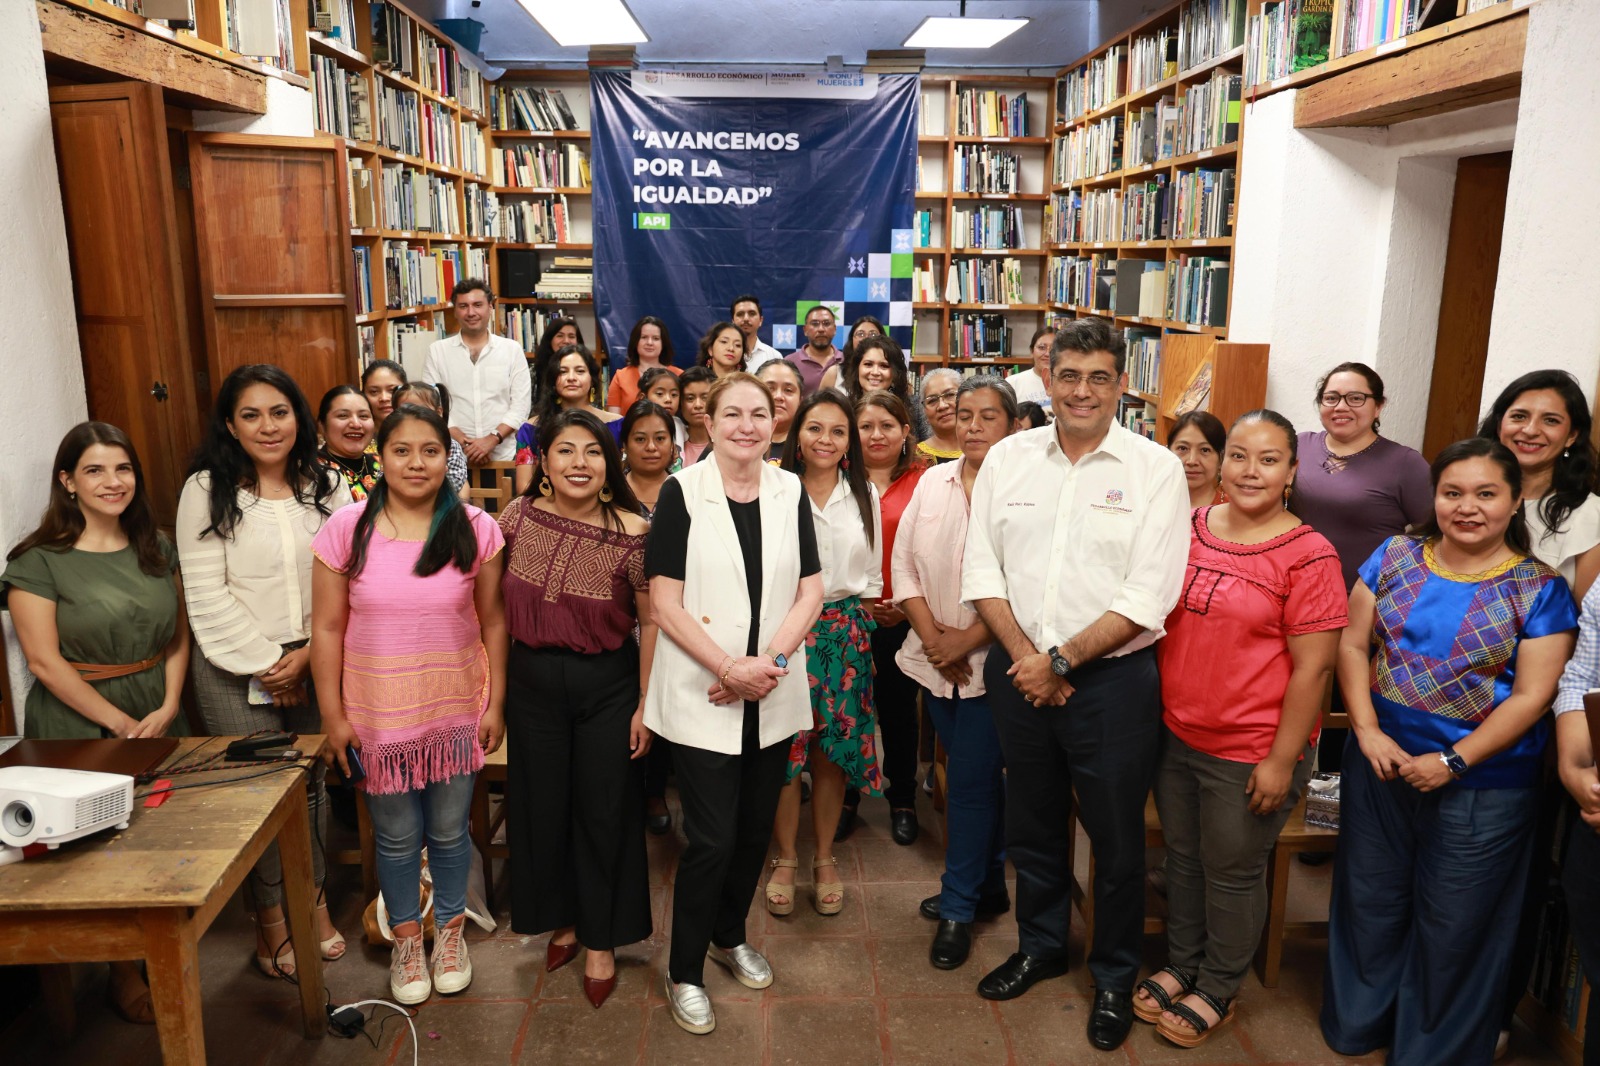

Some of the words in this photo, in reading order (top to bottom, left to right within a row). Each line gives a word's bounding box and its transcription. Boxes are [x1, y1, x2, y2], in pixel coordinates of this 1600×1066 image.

[1303, 5, 1328, 13] GARDEN
[717, 72, 763, 80] ECONÓMICO
[633, 130, 800, 151] “AVANCEMOS
[633, 159, 684, 177] POR
[691, 159, 723, 177] LA
[633, 186, 773, 205] IGUALDAD”
[642, 216, 667, 227] API
